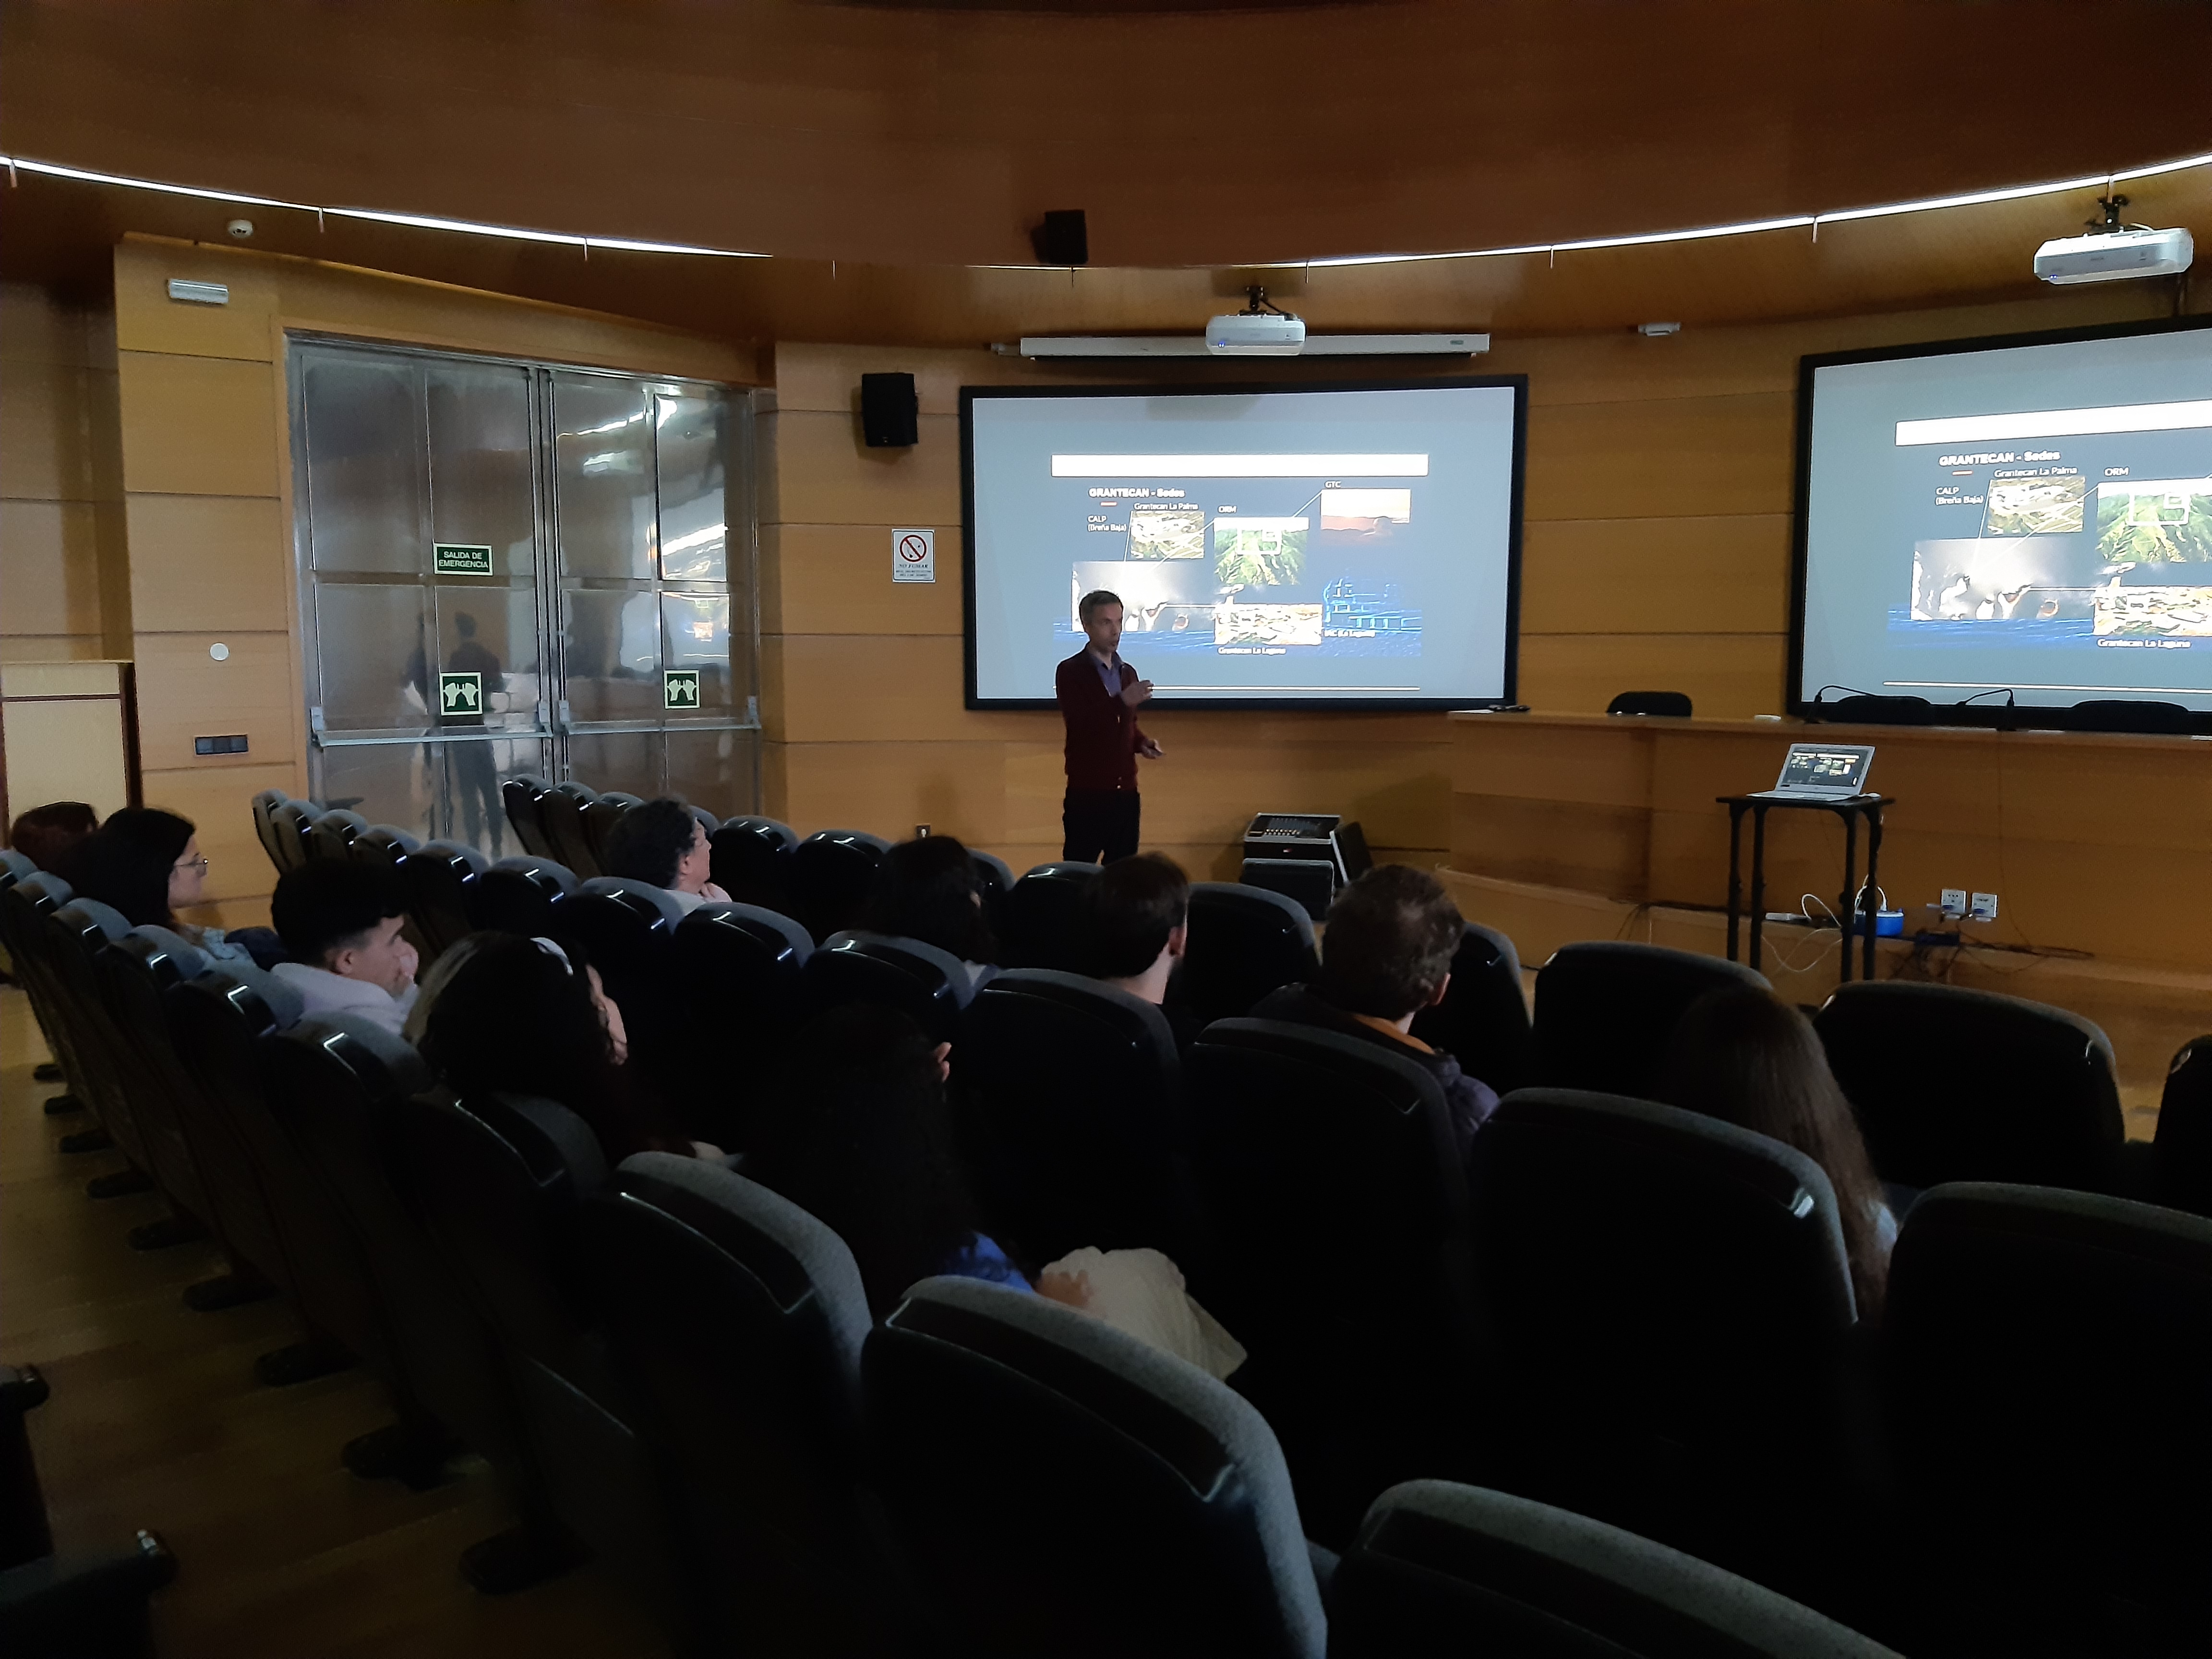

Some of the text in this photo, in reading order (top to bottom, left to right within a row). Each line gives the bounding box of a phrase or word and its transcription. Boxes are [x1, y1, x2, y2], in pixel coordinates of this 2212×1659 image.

[1939, 453, 2014, 466] GRANTECAN
[2024, 450, 2060, 461] Sedes
[1994, 469, 2037, 478] Grantecan
[2051, 467, 2077, 475] Palma
[2104, 468, 2129, 476] ORM
[1089, 488, 1149, 497] GRANTECAN
[1156, 488, 1185, 497] Sedes
[1936, 487, 1960, 495] CALP
[438, 560, 488, 568] EMERGENCIA
[2097, 638, 2144, 648] Grantecan
[2145, 639, 2156, 648] La
